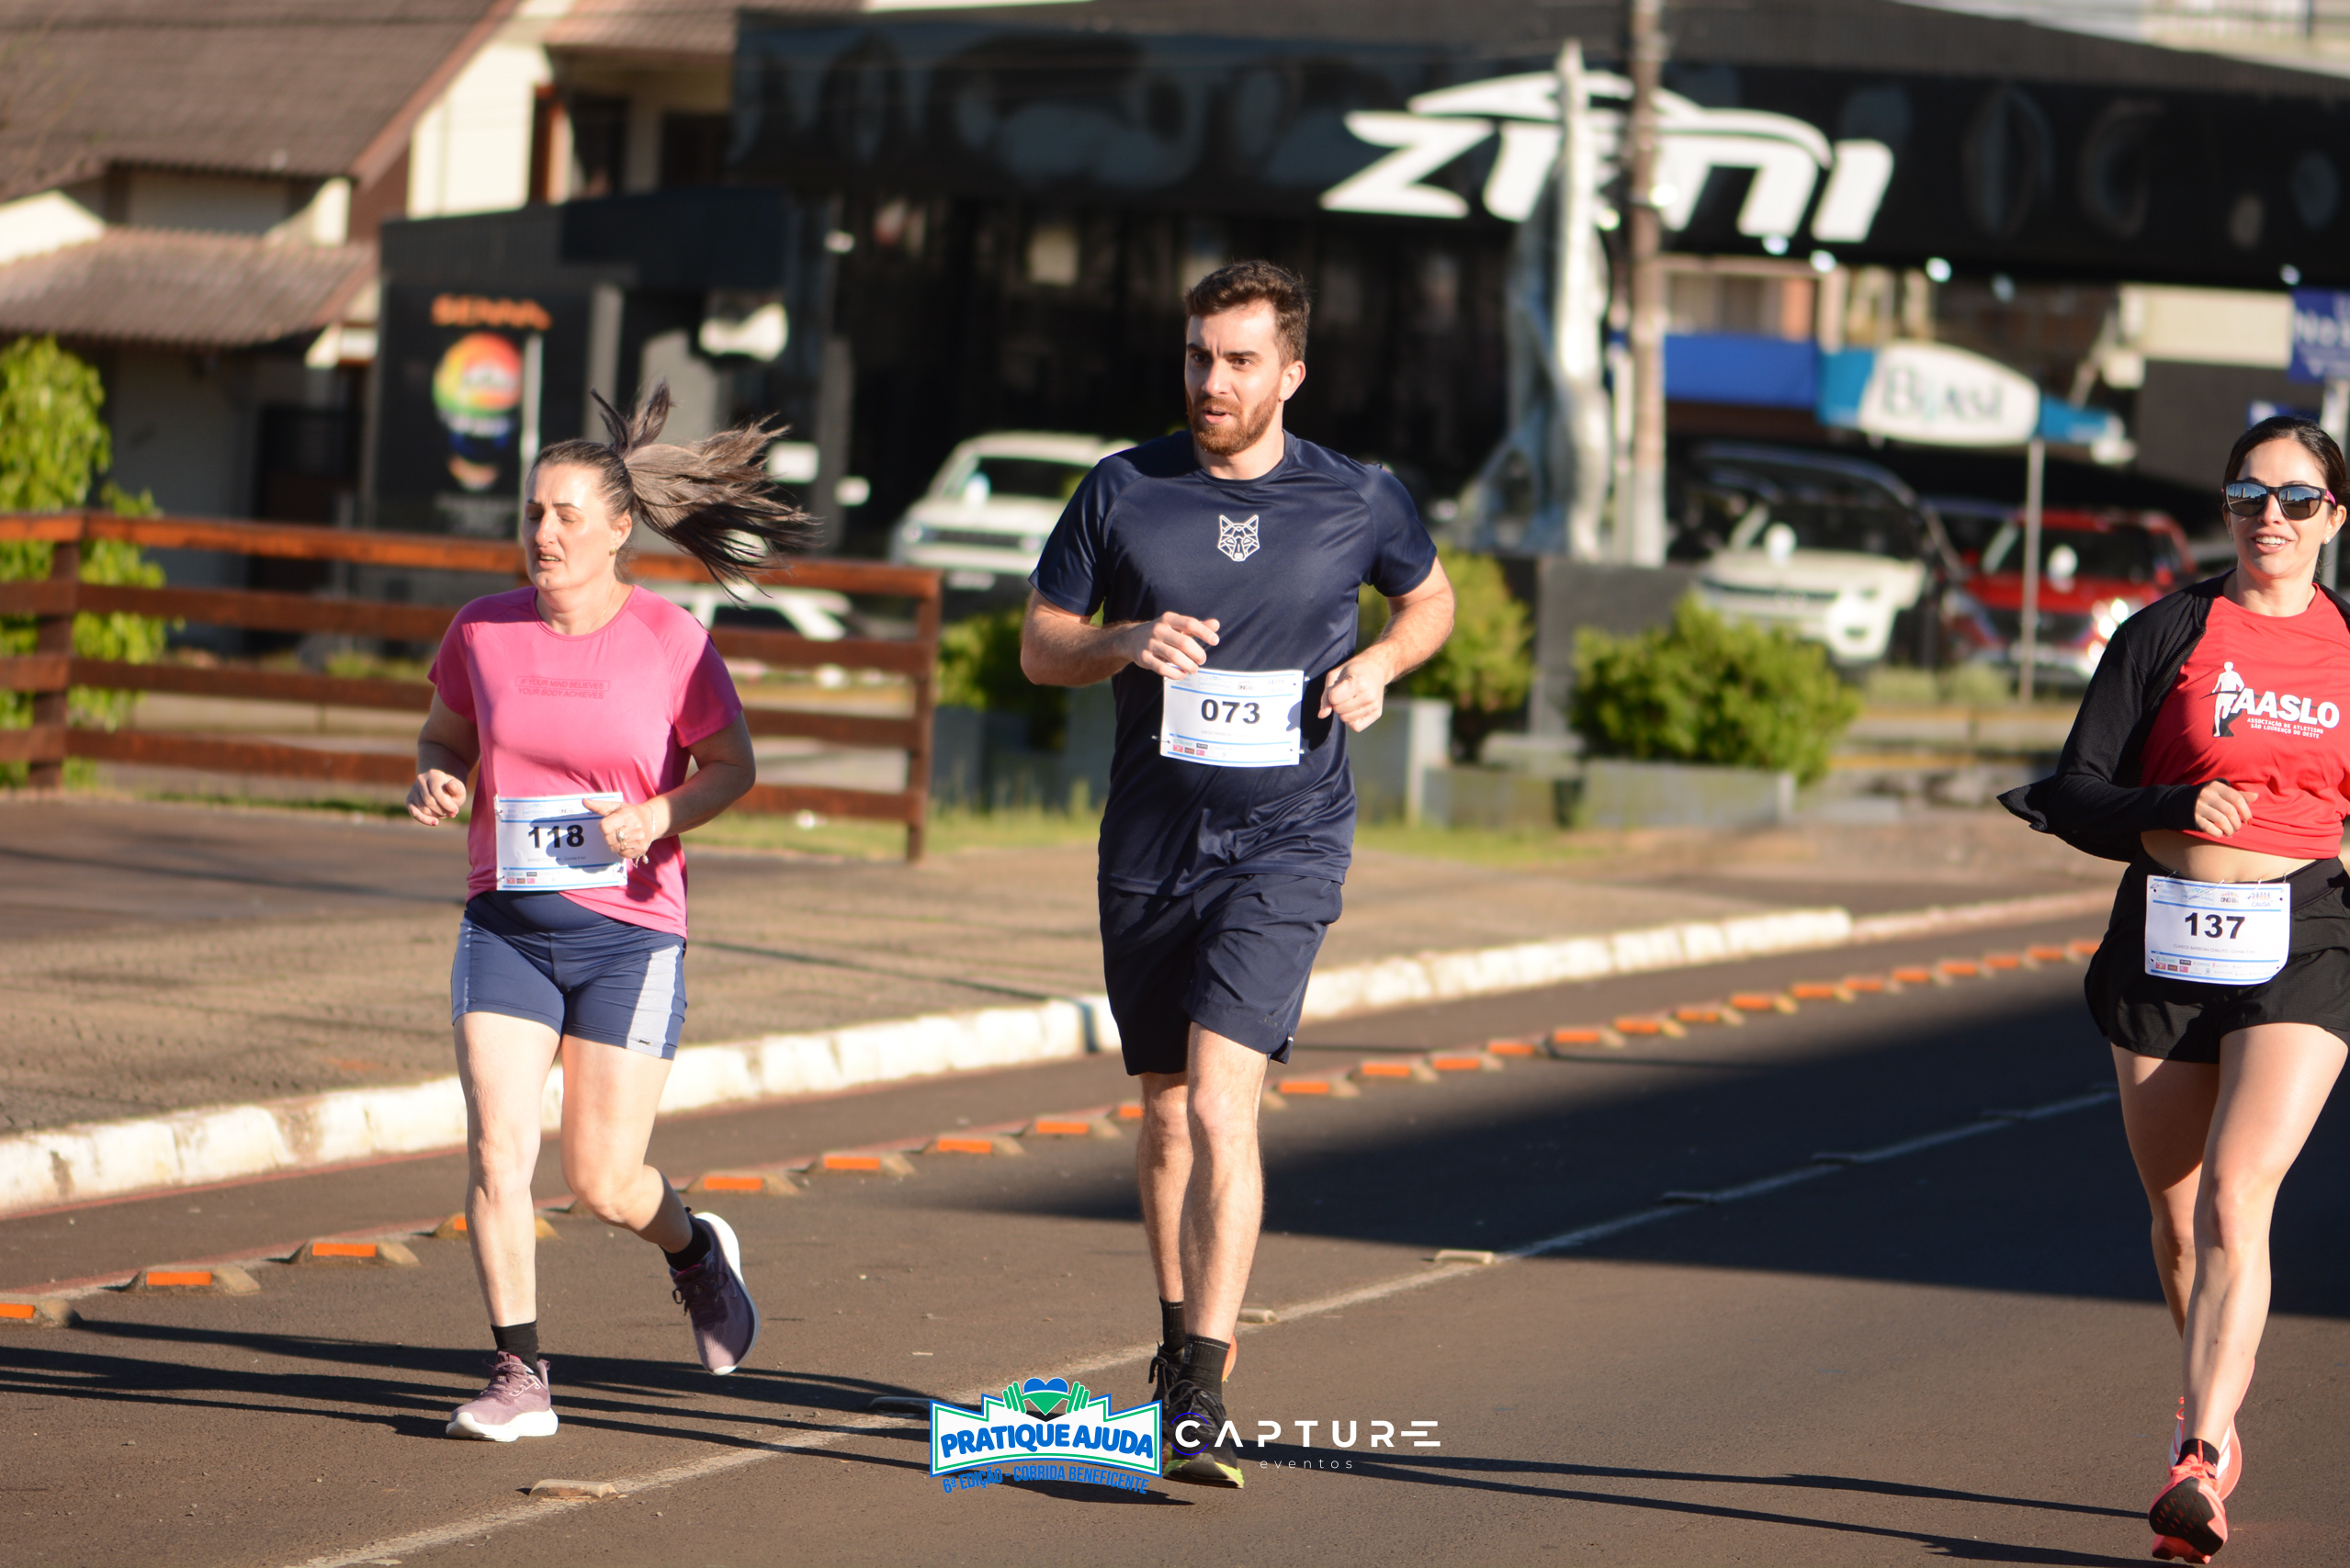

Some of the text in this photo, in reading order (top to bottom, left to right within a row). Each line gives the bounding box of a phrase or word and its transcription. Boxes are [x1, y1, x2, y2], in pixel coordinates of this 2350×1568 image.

[518, 687, 604, 700] YOUR BODY ACHIEVES
[528, 679, 548, 687] YOUR
[569, 682, 604, 690] BELIEVES
[1201, 699, 1260, 725] 073
[2230, 687, 2340, 728] AASLO
[2247, 717, 2283, 728] ASSOCIAÇÃO
[2292, 724, 2324, 735] ATLETISMO
[2263, 724, 2292, 735] LOURENÇO
[2302, 731, 2320, 739] OESTE
[528, 824, 584, 849] 118
[2185, 912, 2245, 940] 137
